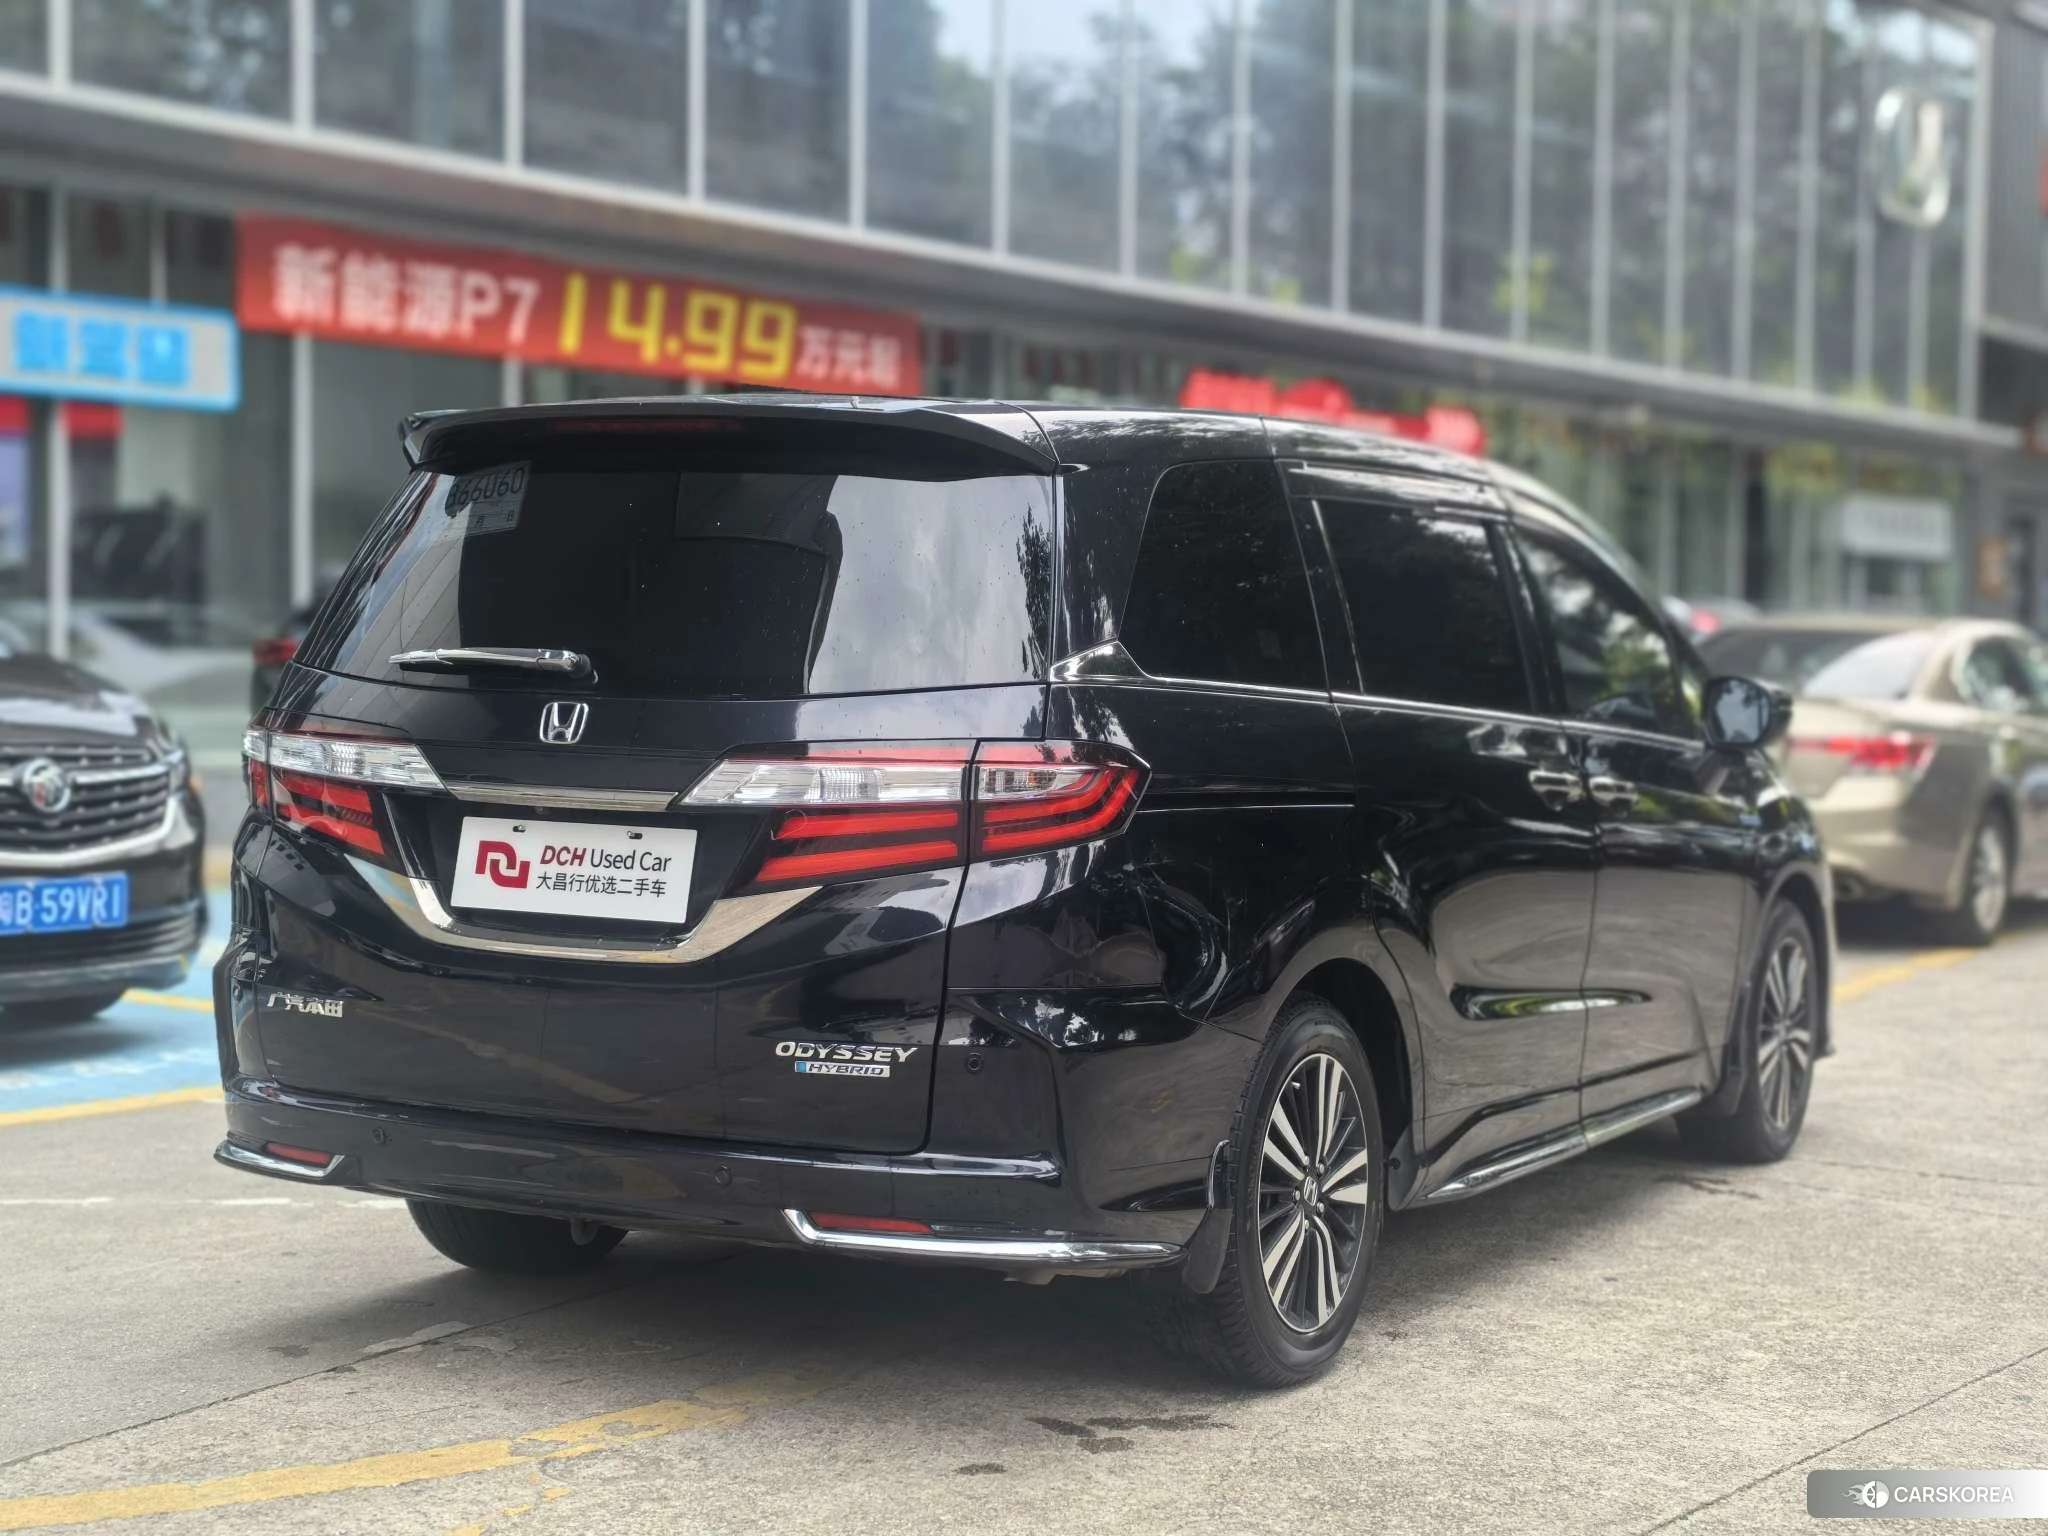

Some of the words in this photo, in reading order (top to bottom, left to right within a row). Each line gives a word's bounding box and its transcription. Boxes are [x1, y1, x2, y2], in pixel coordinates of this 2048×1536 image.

[540, 845, 586, 867] DCH
[590, 849, 635, 872] Used
[640, 852, 672, 872] Car
[536, 872, 667, 898] 大昌行优选二手车
[267, 992, 344, 1018] 广汽本田
[775, 1041, 918, 1063] ODYSSEY
[808, 1063, 885, 1076] HYBRID
